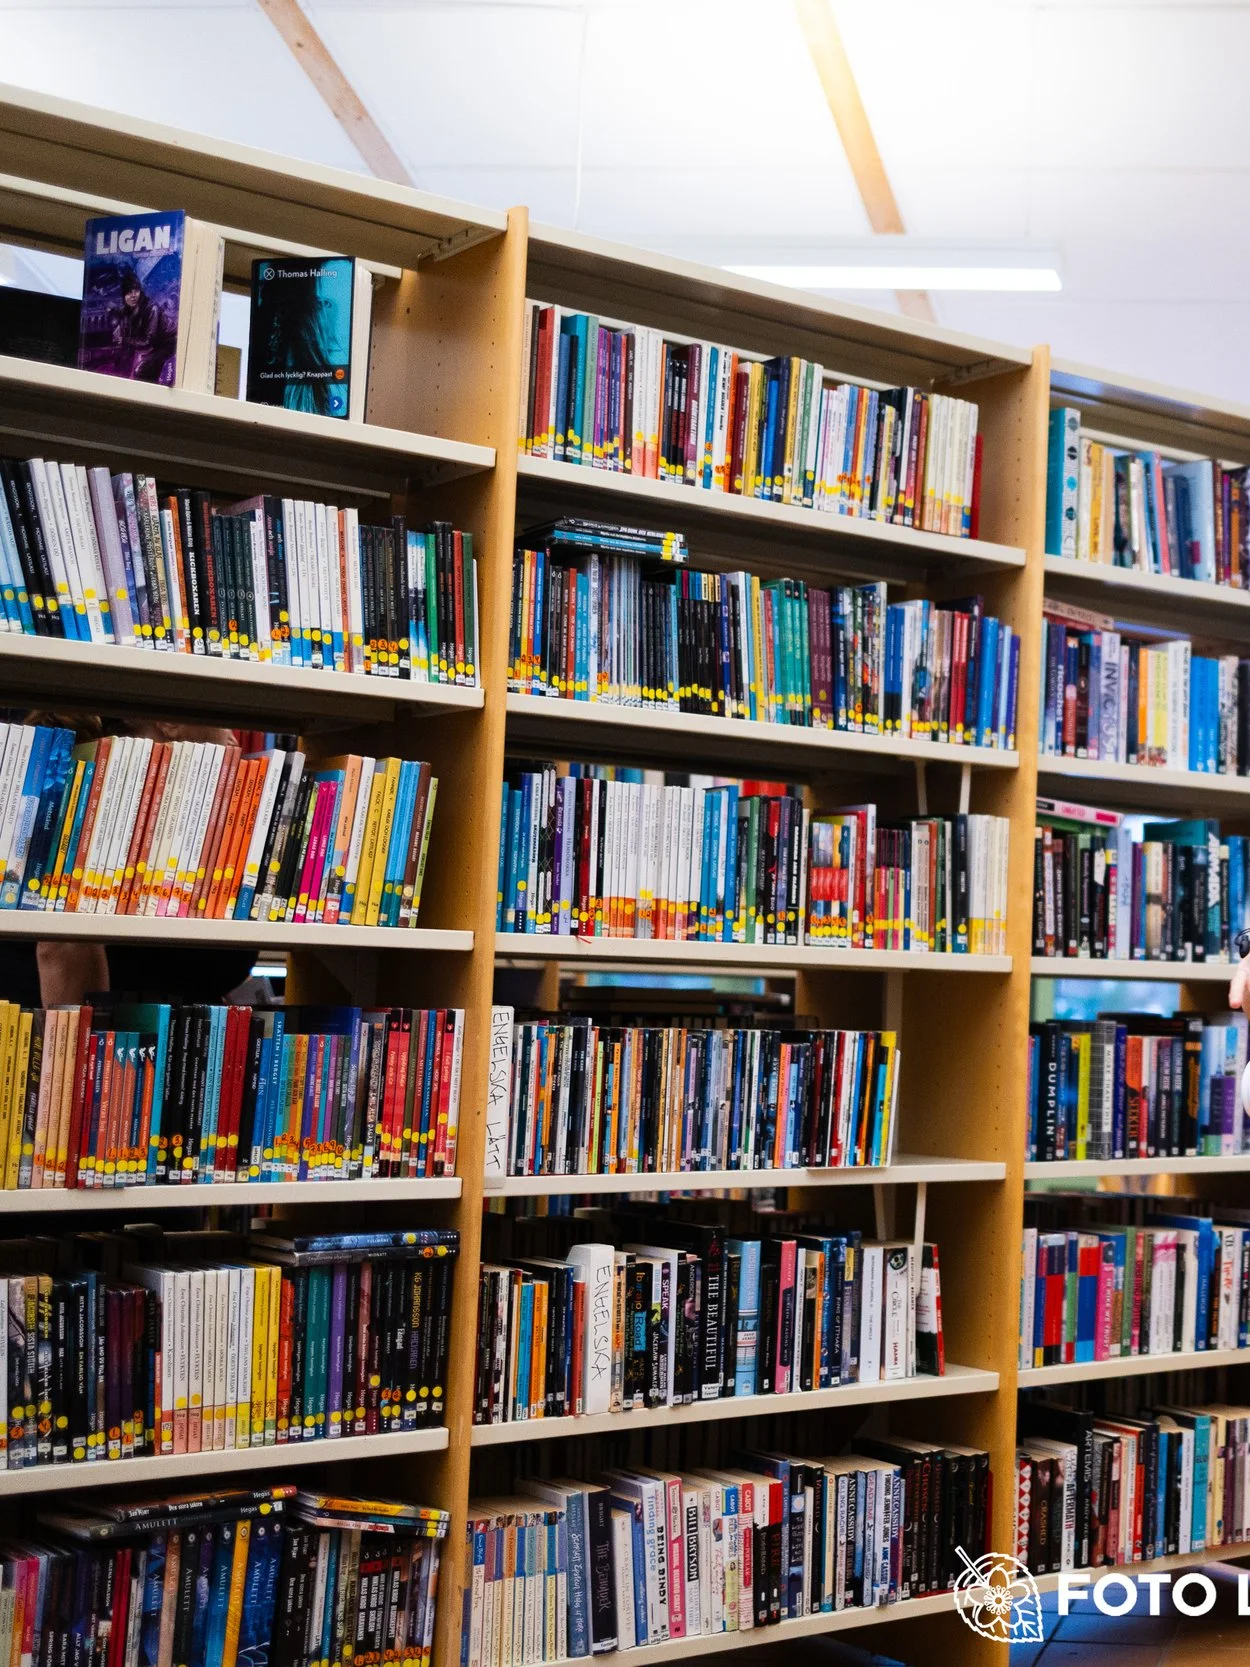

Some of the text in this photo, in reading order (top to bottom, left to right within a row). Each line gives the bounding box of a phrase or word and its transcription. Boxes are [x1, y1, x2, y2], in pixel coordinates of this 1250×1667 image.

[96, 225, 170, 255] LIGAN
[278, 269, 337, 278] Thomas Halling
[286, 371, 306, 379] lycklig?
[307, 371, 333, 379] Knappast
[189, 552, 200, 615] KICKBOXAREN
[207, 554, 216, 617] KICKBOXAREN
[1056, 665, 1064, 722] ricochet
[274, 1021, 282, 1051] SKATTEN
[486, 1012, 510, 1170] ENGELSKA LÄTT
[1046, 1062, 1057, 1142] DUMPLIN'
[1128, 1096, 1140, 1138] SEEKER
[412, 1272, 422, 1328] KG JOHANSSON
[661, 1279, 669, 1309] SPEAK
[27, 1332, 35, 1350] SISTA
[592, 1266, 611, 1381] ENGELSKA
[635, 1316, 644, 1346] Road
[705, 1275, 719, 1371] THE BEAUTIFUL
[833, 1325, 841, 1354] ITHAKA
[1084, 1430, 1092, 1482] ARTEMIS
[922, 1463, 931, 1512] CHOSEN
[1065, 1483, 1075, 1530] AFTERMATH
[135, 1518, 177, 1531] AMULETT
[240, 1506, 257, 1514] Hegas
[883, 1497, 891, 1525] JENNIFER
[891, 1500, 899, 1539] CASSIDY
[647, 1495, 657, 1571] finding grace
[657, 1526, 665, 1564] BEING
[688, 1508, 697, 1580] BILL BRYSON
[882, 1526, 890, 1543] JONES
[150, 1574, 160, 1616] AMULETT
[169, 1554, 178, 1597] AMULETT
[182, 1568, 192, 1611] AMULETT
[199, 1566, 209, 1609] AMULETT
[218, 1565, 227, 1608] AMULETT
[234, 1562, 244, 1606] AMULETT
[251, 1561, 262, 1604] AMULETT
[265, 1558, 276, 1600] AMULETT
[392, 1571, 400, 1588] NIKLAS
[596, 1541, 610, 1612] THE BEHOLDER
[356, 1611, 366, 1640] KARAVANEN
